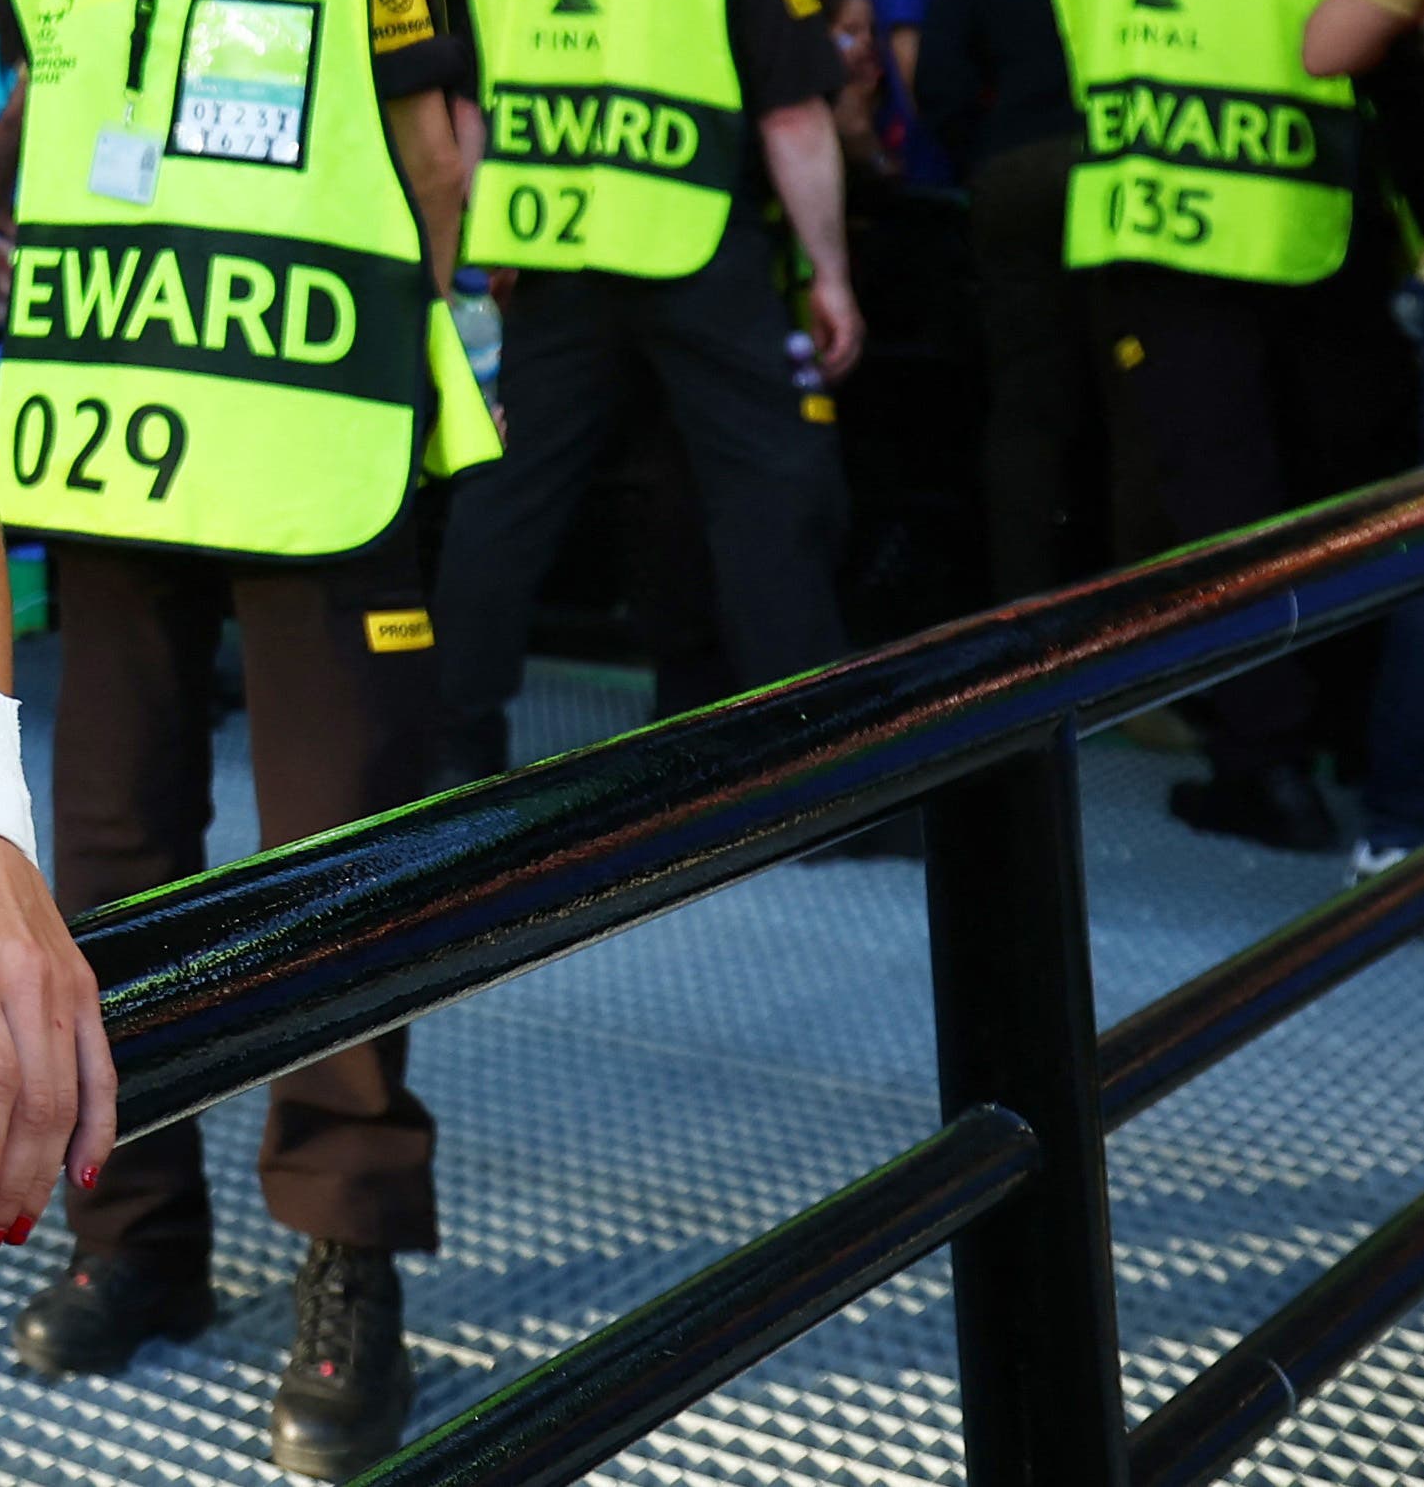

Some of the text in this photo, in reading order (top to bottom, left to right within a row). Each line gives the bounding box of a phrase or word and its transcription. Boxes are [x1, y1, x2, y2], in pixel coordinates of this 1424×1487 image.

[1087, 85, 1316, 167] EWARD
[508, 185, 595, 245] 02
[8, 246, 357, 365] EWARD
[13, 393, 189, 502] 029
